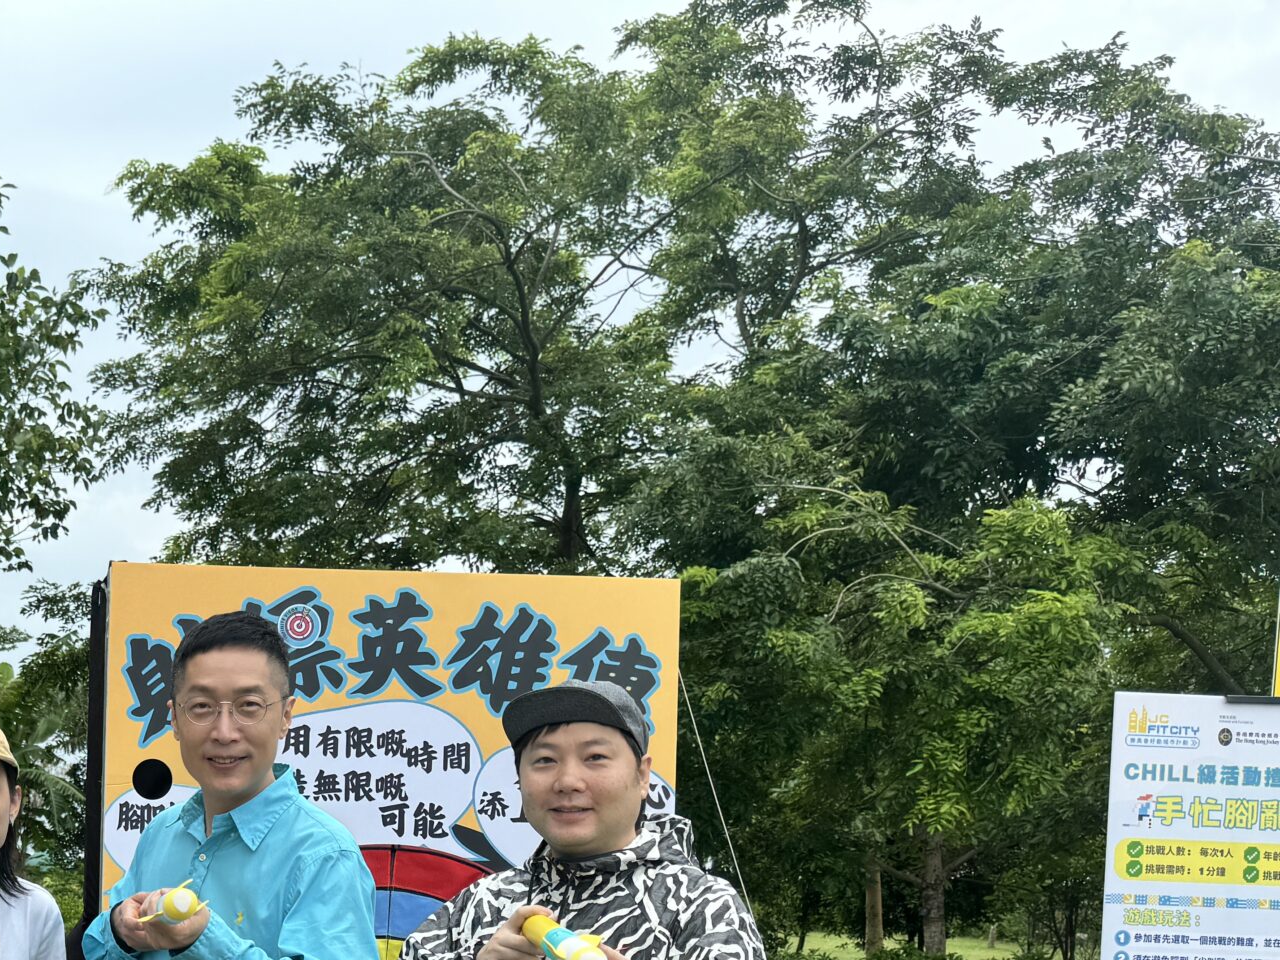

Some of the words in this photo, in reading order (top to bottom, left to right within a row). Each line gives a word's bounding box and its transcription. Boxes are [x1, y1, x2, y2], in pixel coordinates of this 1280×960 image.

[1148, 714, 1169, 724] JC
[1148, 724, 1169, 735] FIT
[1170, 725, 1200, 736] CITY
[378, 801, 450, 840] 可能
